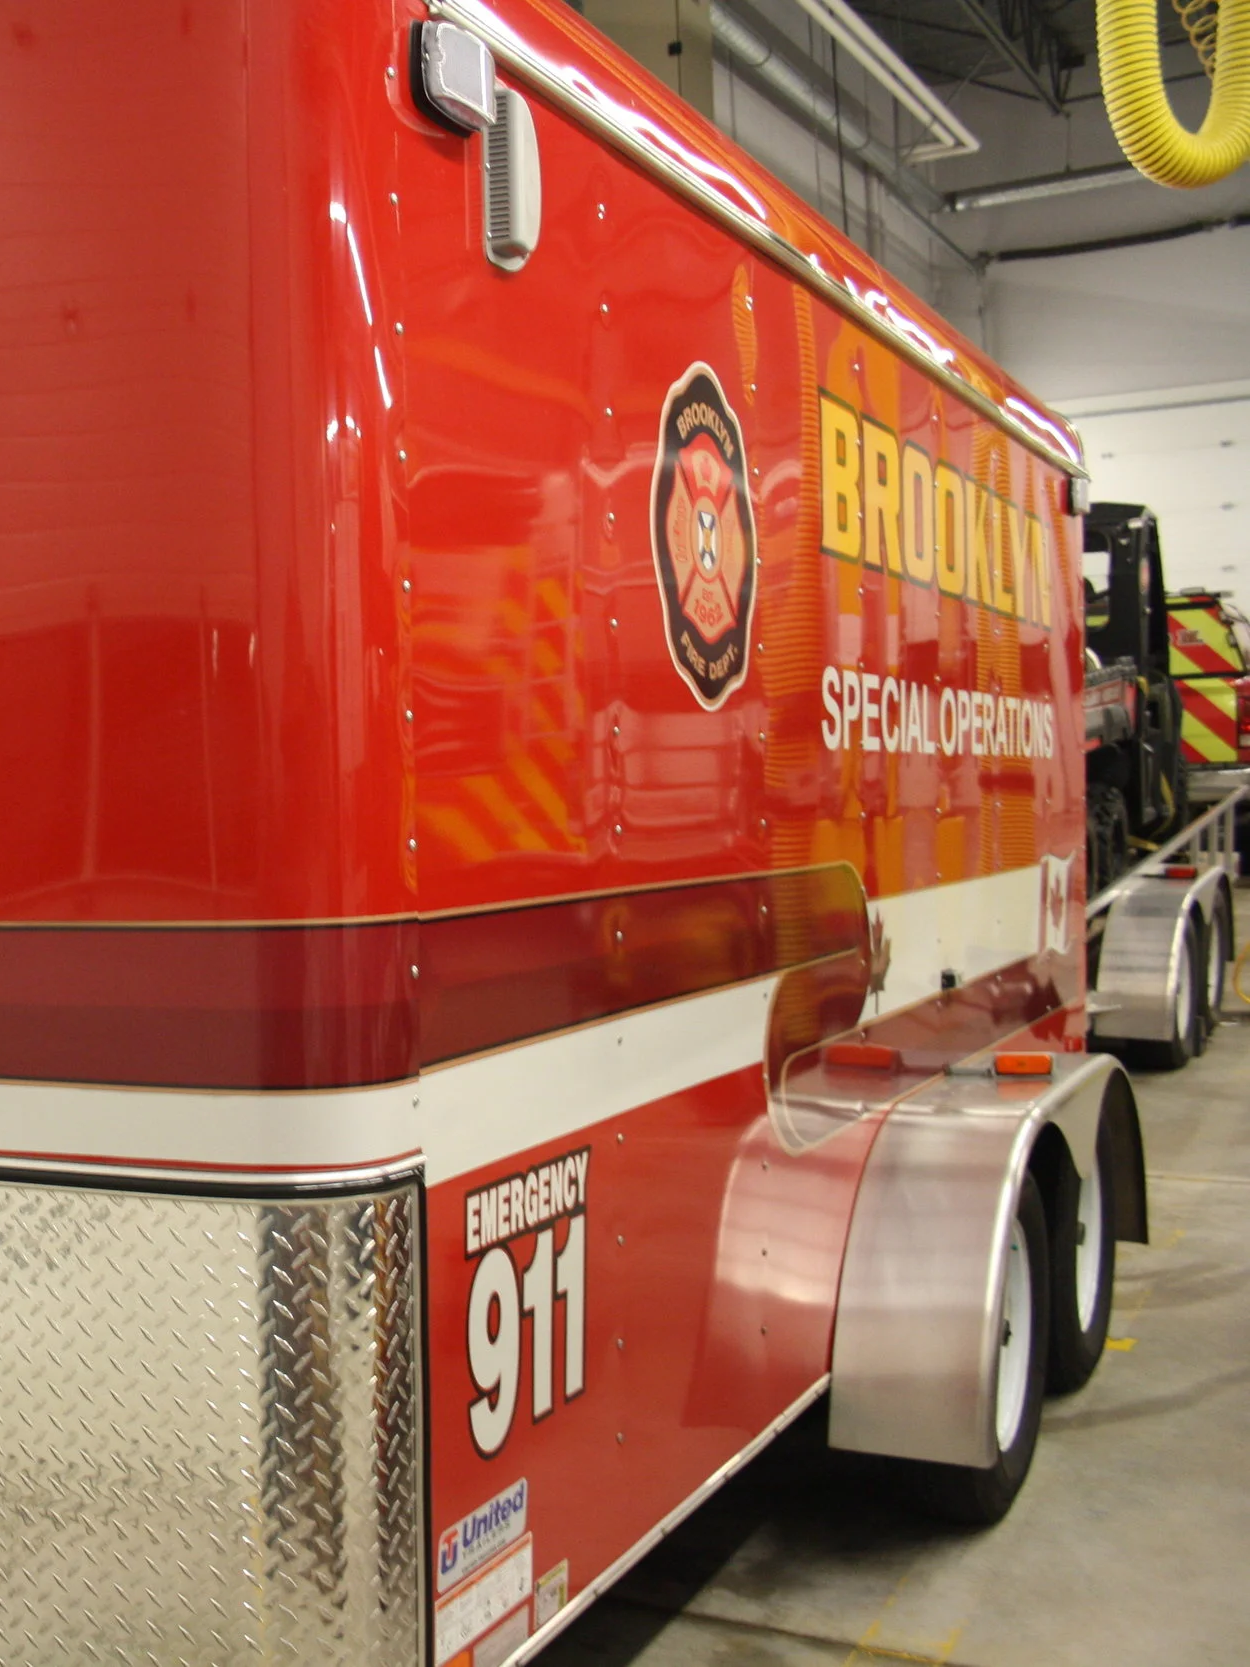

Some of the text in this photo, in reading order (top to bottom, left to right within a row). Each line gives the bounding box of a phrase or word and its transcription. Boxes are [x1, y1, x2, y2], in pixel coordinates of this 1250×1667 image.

[676, 402, 734, 460] BROOKLYN
[818, 390, 1051, 631] BROOKLYN
[680, 629, 707, 678] FIRE
[821, 665, 1054, 759] SPECIAL OPERATIONS
[465, 1148, 590, 1255] EMERGENCY
[467, 1211, 586, 1456] 911
[462, 1481, 525, 1548] United
